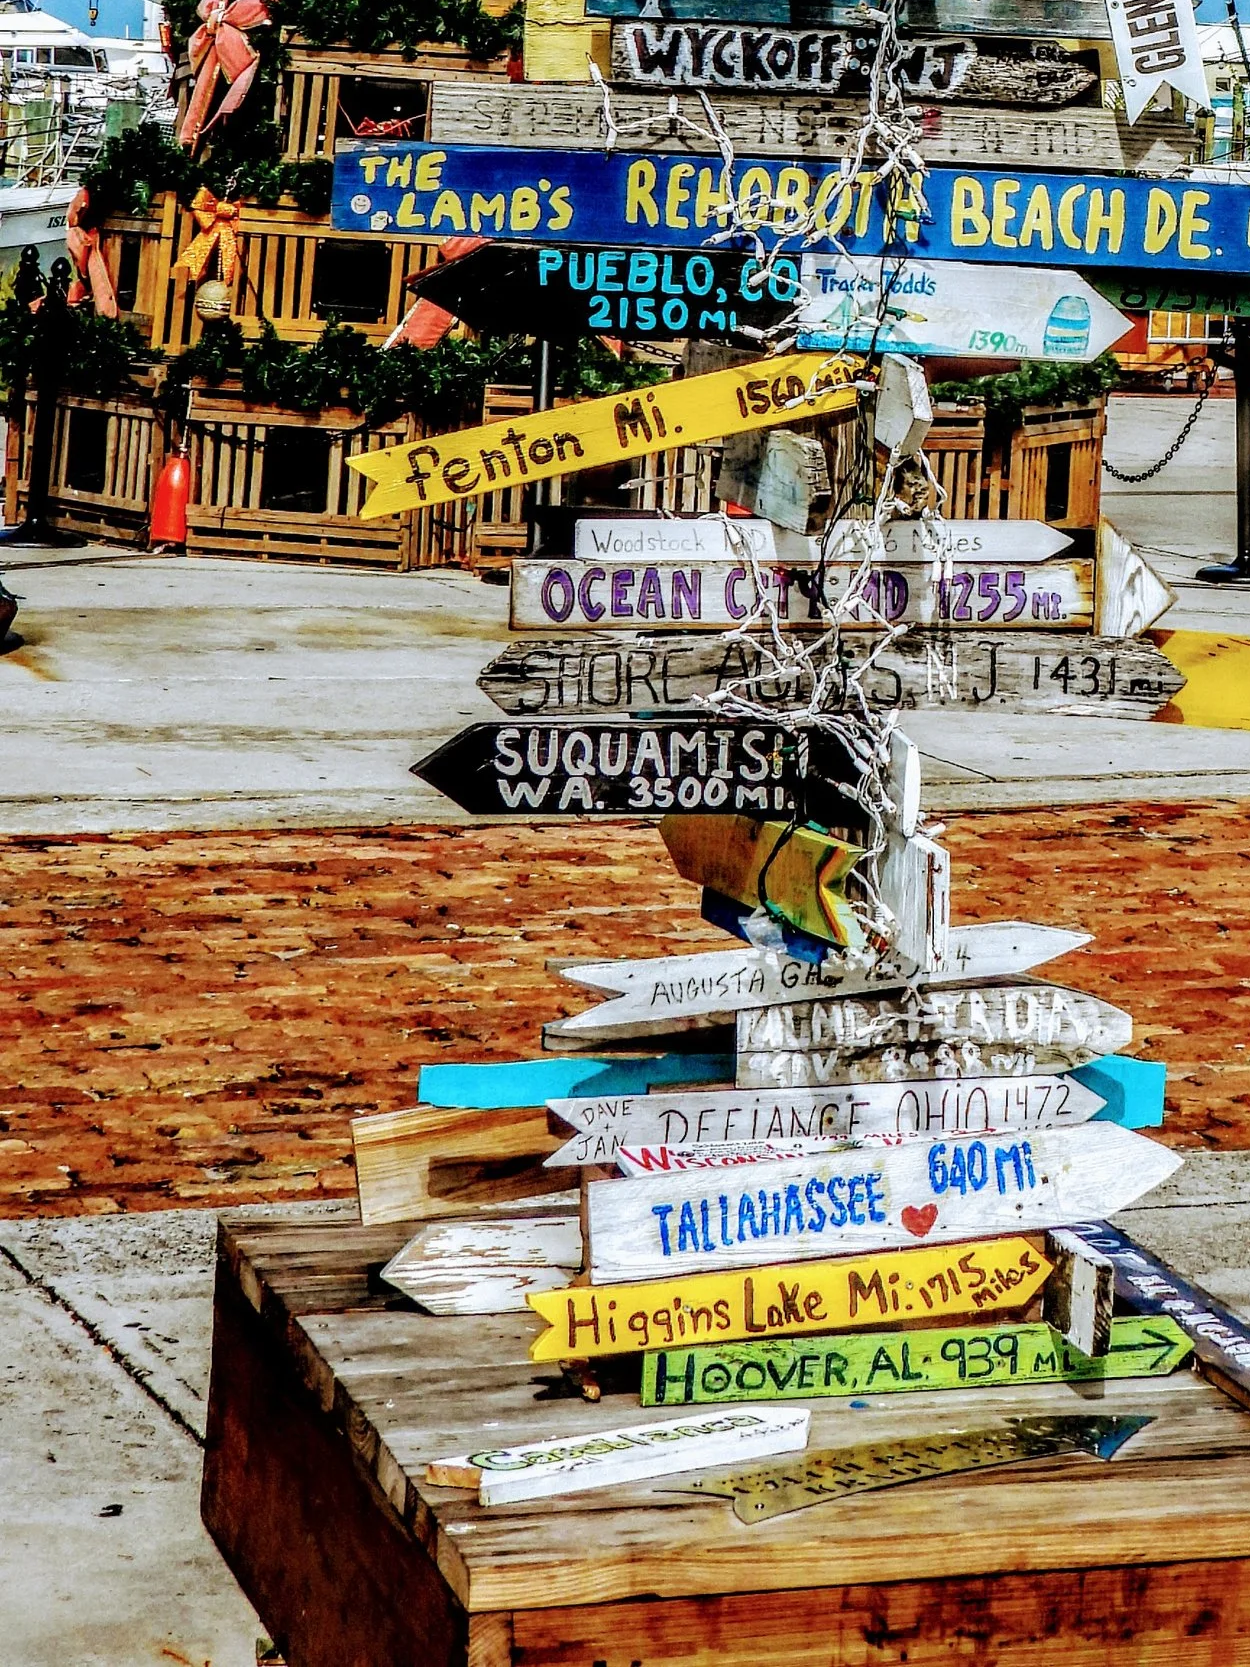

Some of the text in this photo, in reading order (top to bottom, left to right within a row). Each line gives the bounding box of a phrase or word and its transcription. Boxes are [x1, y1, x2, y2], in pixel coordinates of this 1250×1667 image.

[359, 151, 448, 192] THE
[950, 175, 1126, 255] BEACH
[538, 249, 727, 303] PUEBLO,
[588, 296, 689, 333] 2150
[541, 567, 702, 623] OCEAN
[627, 776, 728, 810] 3500
[649, 967, 767, 1007] AUGUSTA
[579, 1099, 636, 1126] DAVE
[1003, 1084, 1075, 1122] 1472
[651, 1172, 888, 1257] TALLAHASSEE
[566, 1296, 731, 1350] Higgins
[743, 1276, 829, 1334] Lake
[940, 1334, 1019, 1380] 939
